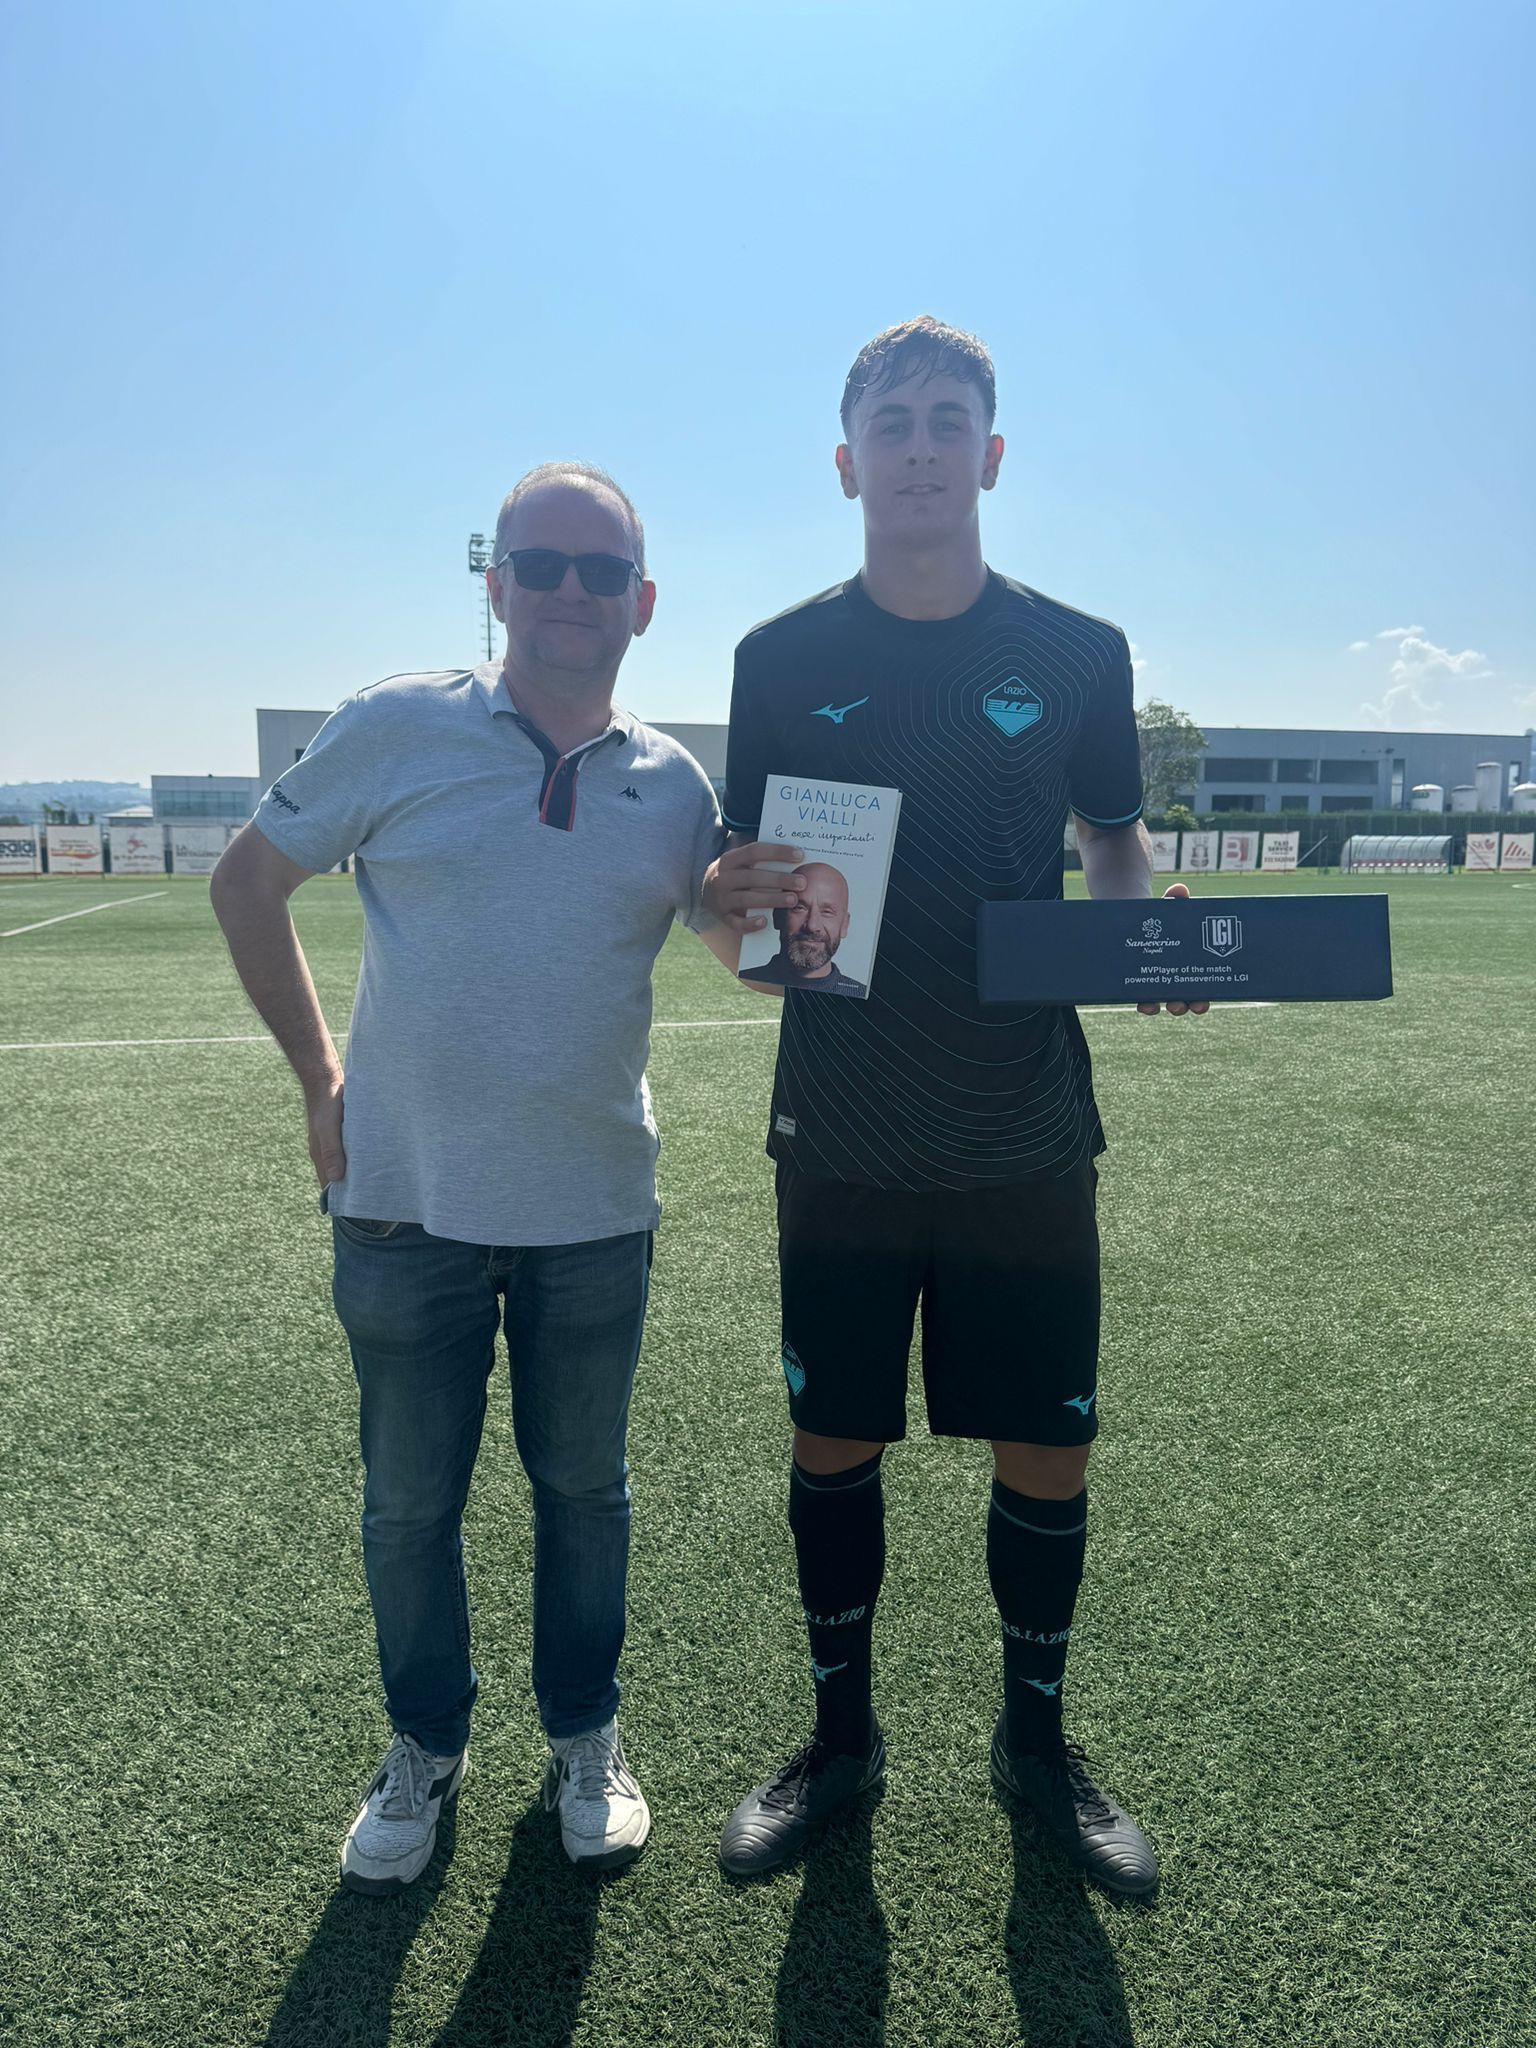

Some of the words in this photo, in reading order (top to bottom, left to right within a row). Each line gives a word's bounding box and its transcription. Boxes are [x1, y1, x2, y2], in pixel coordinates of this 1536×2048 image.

[1003, 686, 1027, 696] LAZIO
[271, 781, 301, 815] Kappa
[780, 785, 880, 811] GIANLUCA
[798, 806, 857, 827] VIALLI
[791, 830, 816, 839] cose
[818, 826, 876, 848] importanti
[1212, 918, 1233, 946] LGI
[1125, 937, 1181, 947] Sanseverino
[1142, 947, 1163, 955] Napoli
[1140, 966, 1179, 975] MVPlayer
[1181, 965, 1190, 973] of
[1191, 965, 1204, 973] the
[1206, 965, 1232, 973] match
[1124, 975, 1160, 984] powered
[1162, 975, 1172, 984] by
[1174, 974, 1225, 983] Sanseverino
[1234, 974, 1249, 982] LGI
